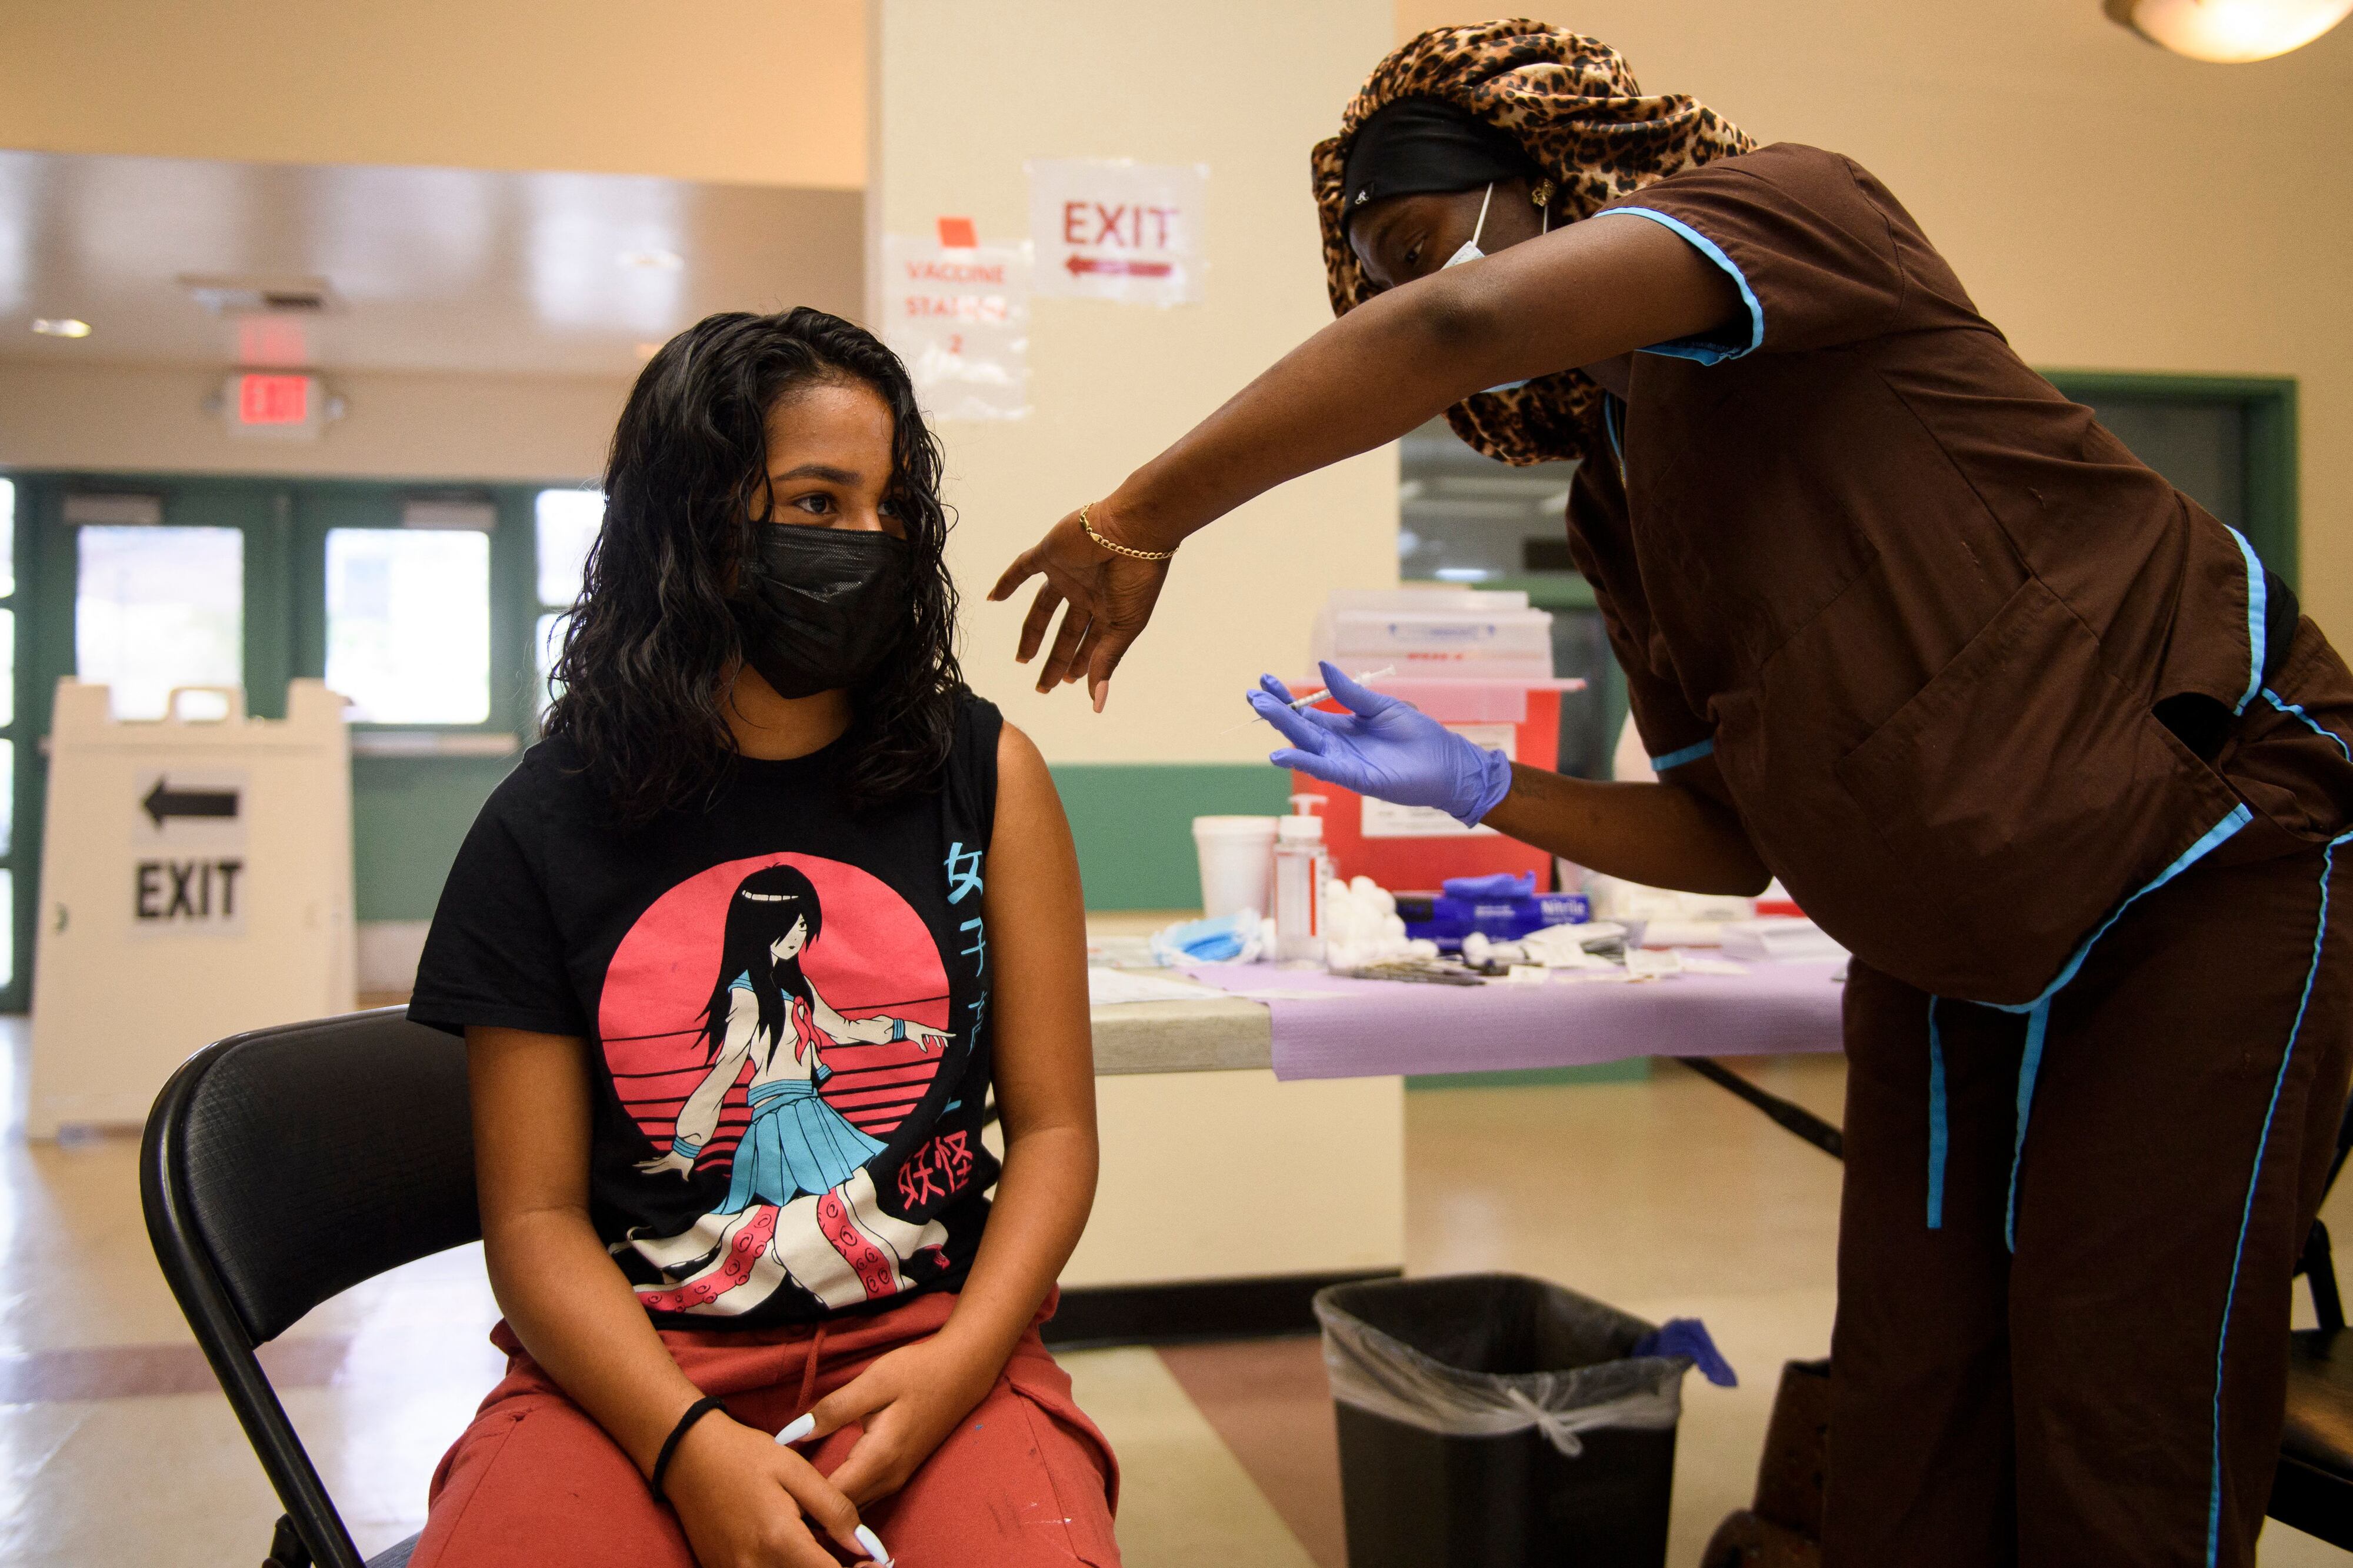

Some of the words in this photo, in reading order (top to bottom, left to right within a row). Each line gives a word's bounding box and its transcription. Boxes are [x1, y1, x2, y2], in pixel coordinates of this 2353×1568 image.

[1064, 200, 1180, 248] EXIT
[135, 859, 244, 921] EXIT
[898, 1129, 973, 1210] 妖怪
